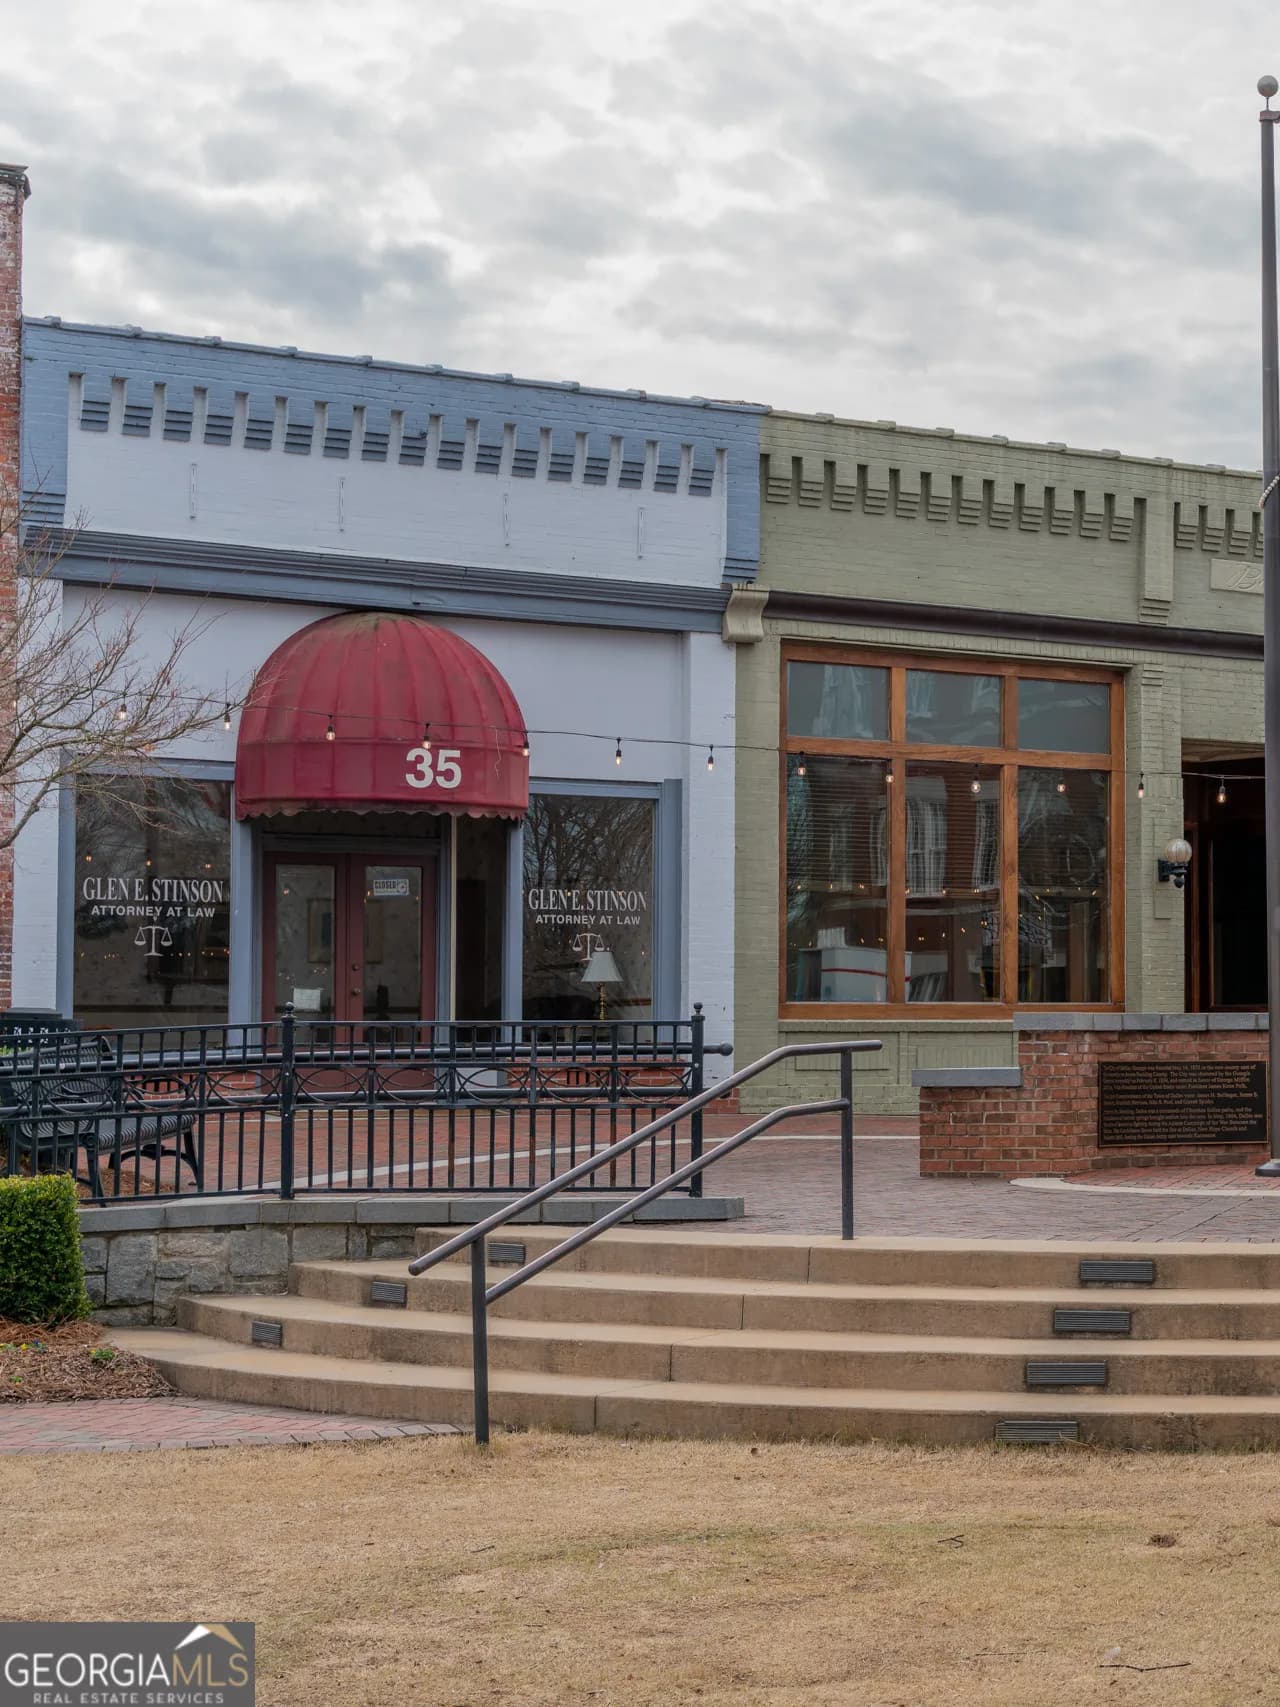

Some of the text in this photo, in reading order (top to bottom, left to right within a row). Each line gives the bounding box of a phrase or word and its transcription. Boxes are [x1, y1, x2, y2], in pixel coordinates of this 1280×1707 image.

[405, 748, 462, 788] 35
[83, 877, 224, 903] GLEN E. STINSON
[528, 888, 647, 912] GLEN E. STINSON
[91, 905, 215, 918] ATTORNEY AT LAW
[535, 914, 641, 925] ATTORNEY AT LAW
